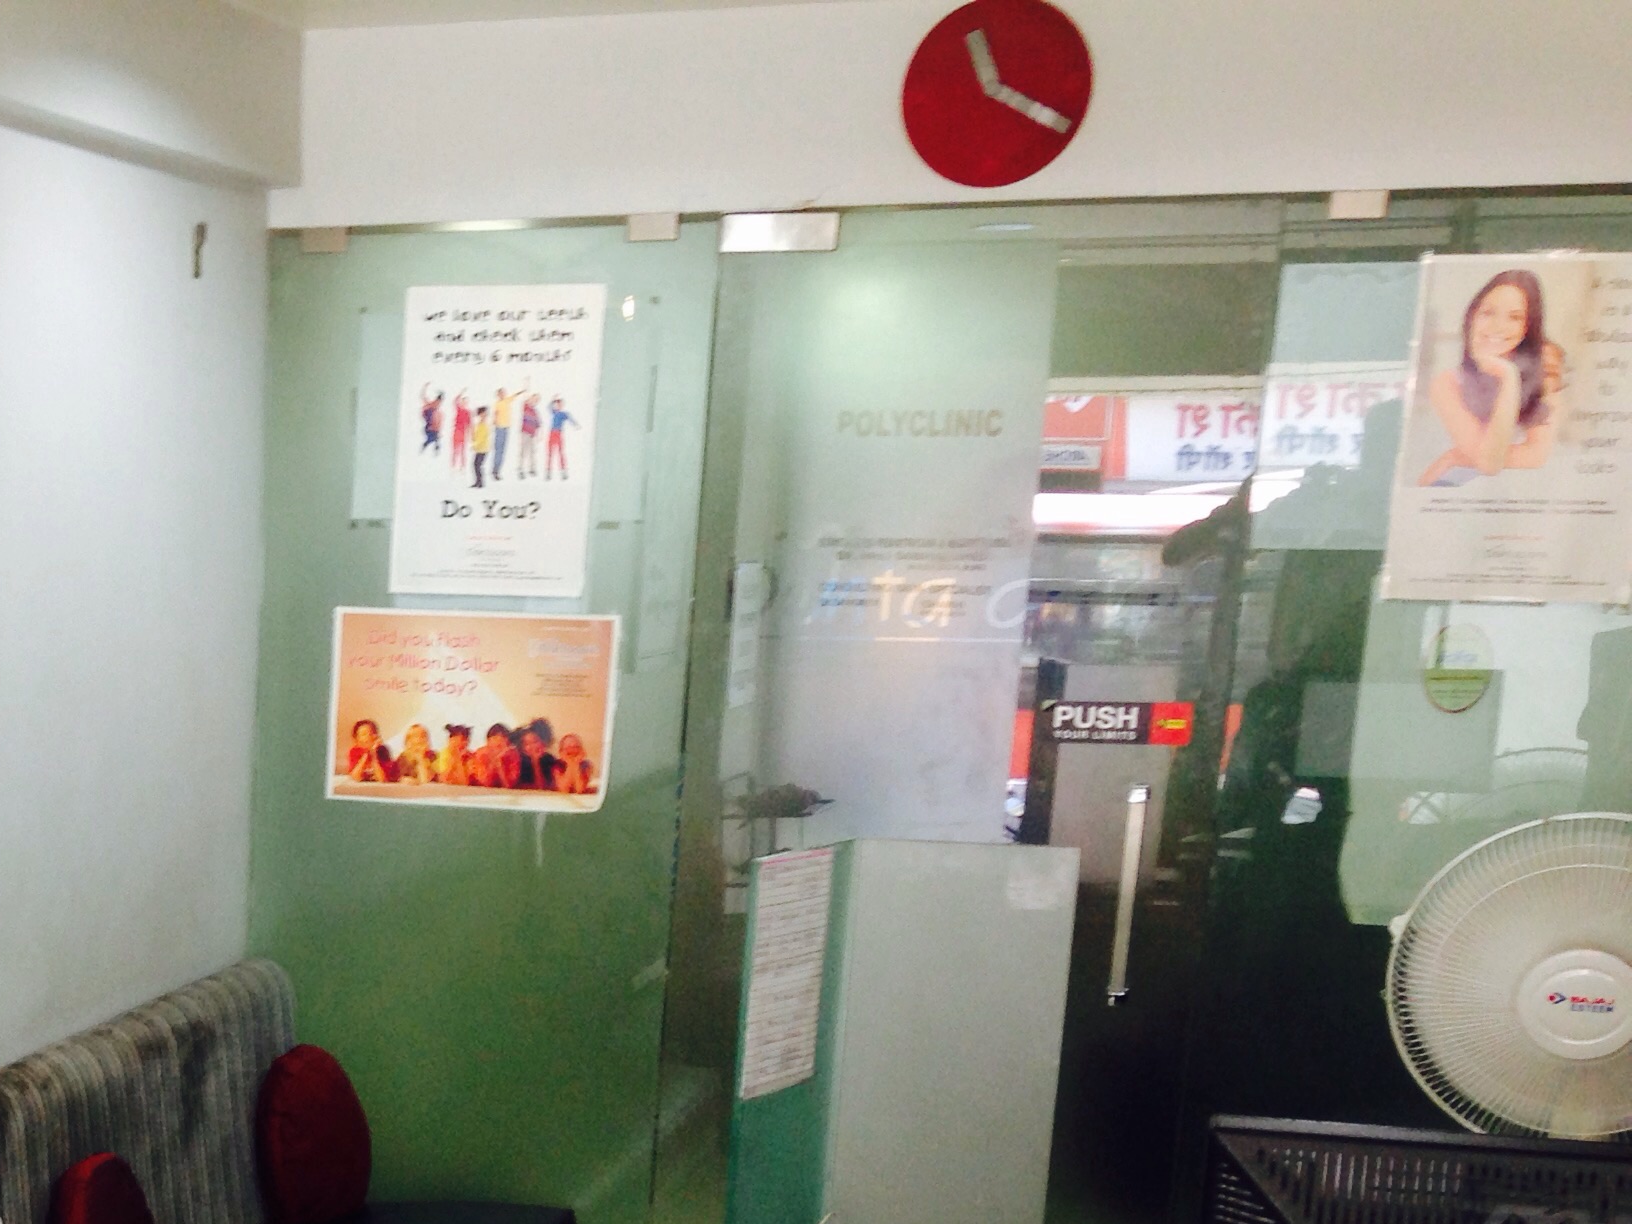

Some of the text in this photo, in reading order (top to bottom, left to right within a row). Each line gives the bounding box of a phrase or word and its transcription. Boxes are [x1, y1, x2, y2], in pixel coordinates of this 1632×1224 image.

[836, 409, 1003, 437] POLYCLINIC
[441, 499, 541, 519] Do You?
[444, 656, 499, 673] Dollar
[1052, 705, 1140, 729] PUSH
[1052, 729, 1089, 739] YOUR
